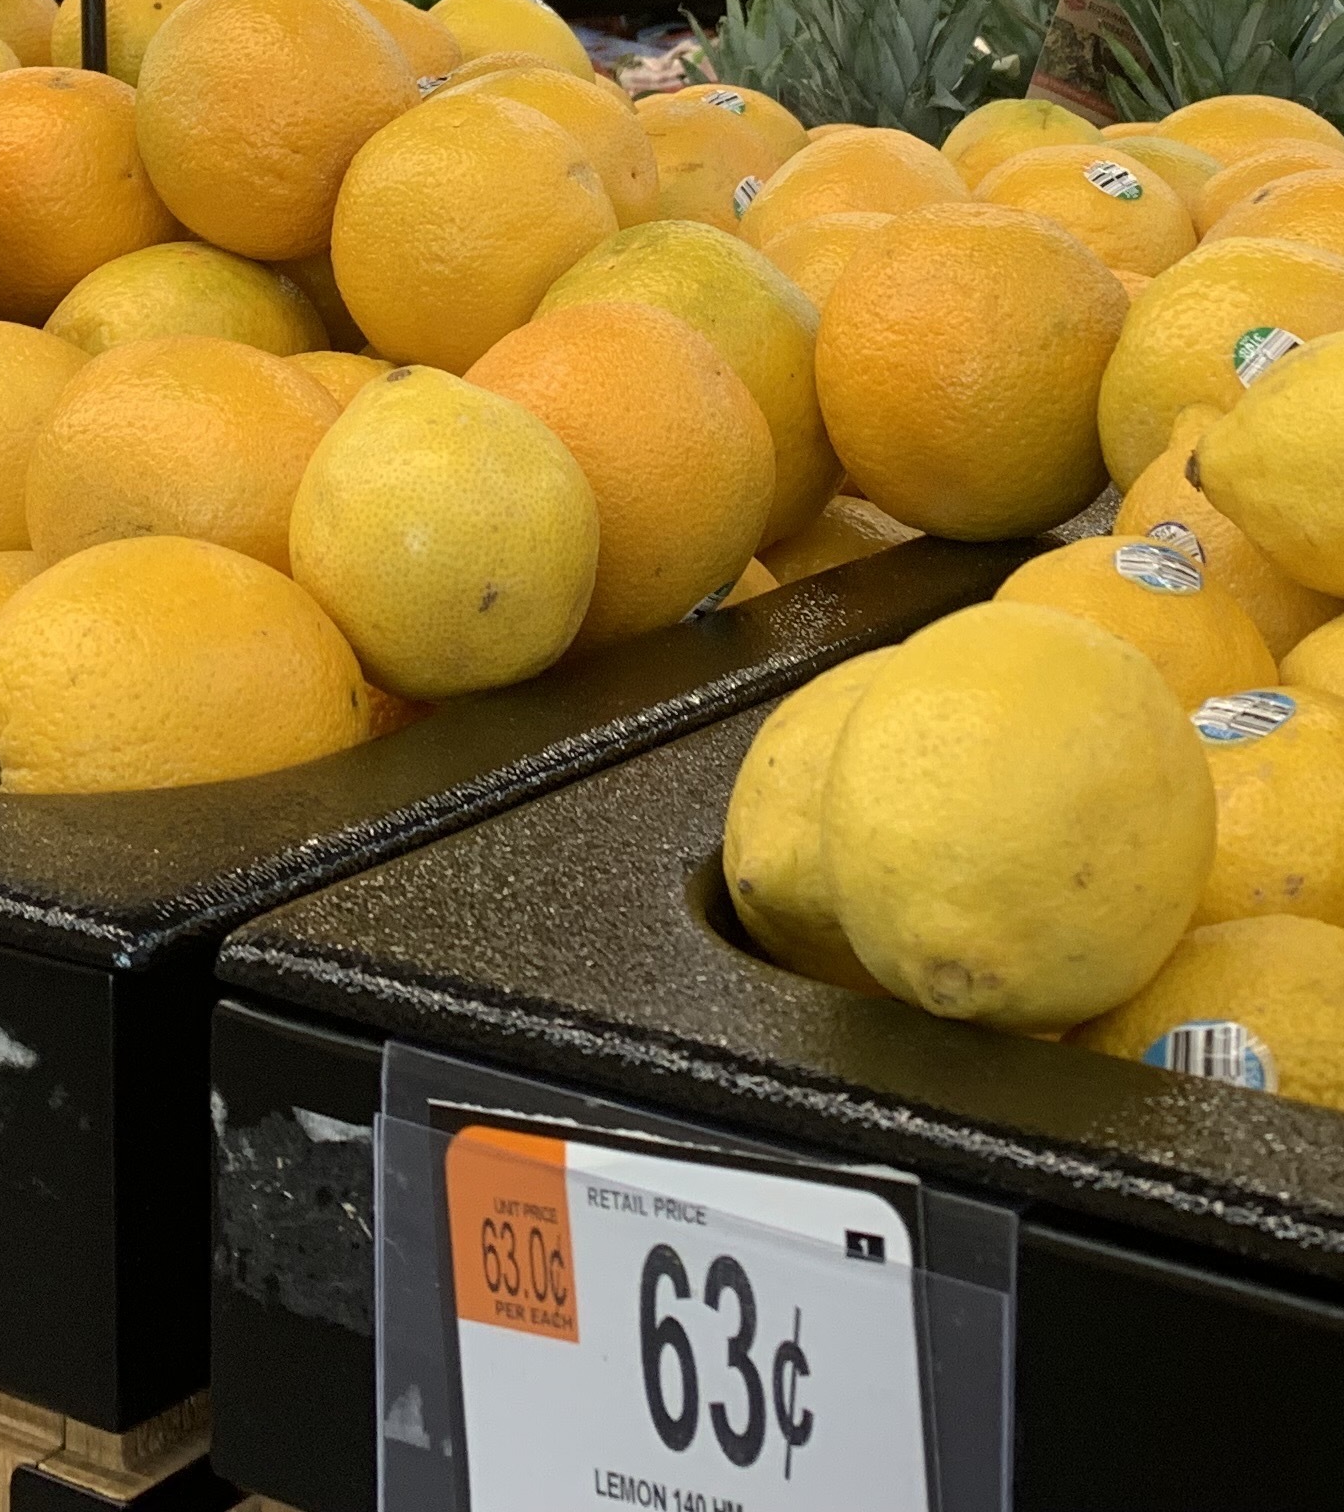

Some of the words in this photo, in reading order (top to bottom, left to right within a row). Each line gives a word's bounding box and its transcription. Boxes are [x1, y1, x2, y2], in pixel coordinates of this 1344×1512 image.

[494, 1197, 519, 1217] UNIT
[523, 1202, 558, 1225] PRICE
[587, 1186, 649, 1217] RETAIL
[654, 1196, 708, 1226] PRICE
[496, 1300, 525, 1322] PER
[531, 1306, 573, 1330] EACH
[639, 1243, 813, 1480] 63¢
[594, 1467, 667, 1512] LEMON
